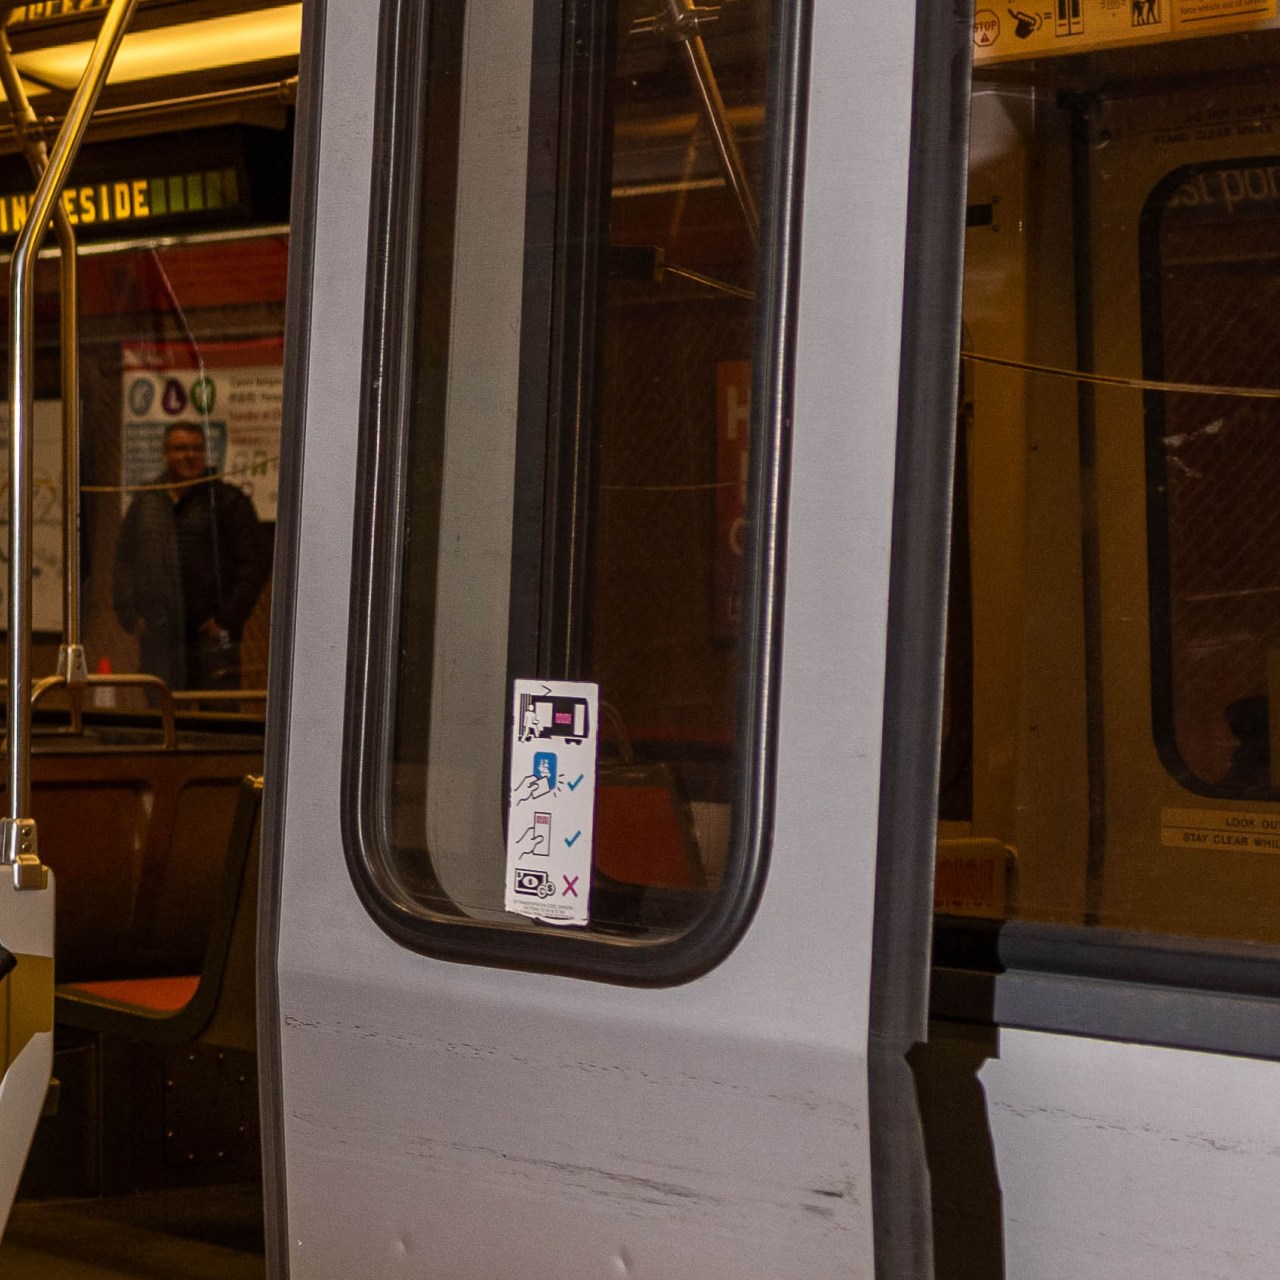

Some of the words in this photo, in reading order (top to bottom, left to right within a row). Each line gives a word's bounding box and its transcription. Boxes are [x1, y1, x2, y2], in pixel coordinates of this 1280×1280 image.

[974, 19, 997, 33] STOP
[1225, 816, 1256, 828] LOOK
[1261, 819, 1280, 830] OU
[1183, 832, 1209, 843] STAY
[1212, 834, 1249, 846] CLEAR
